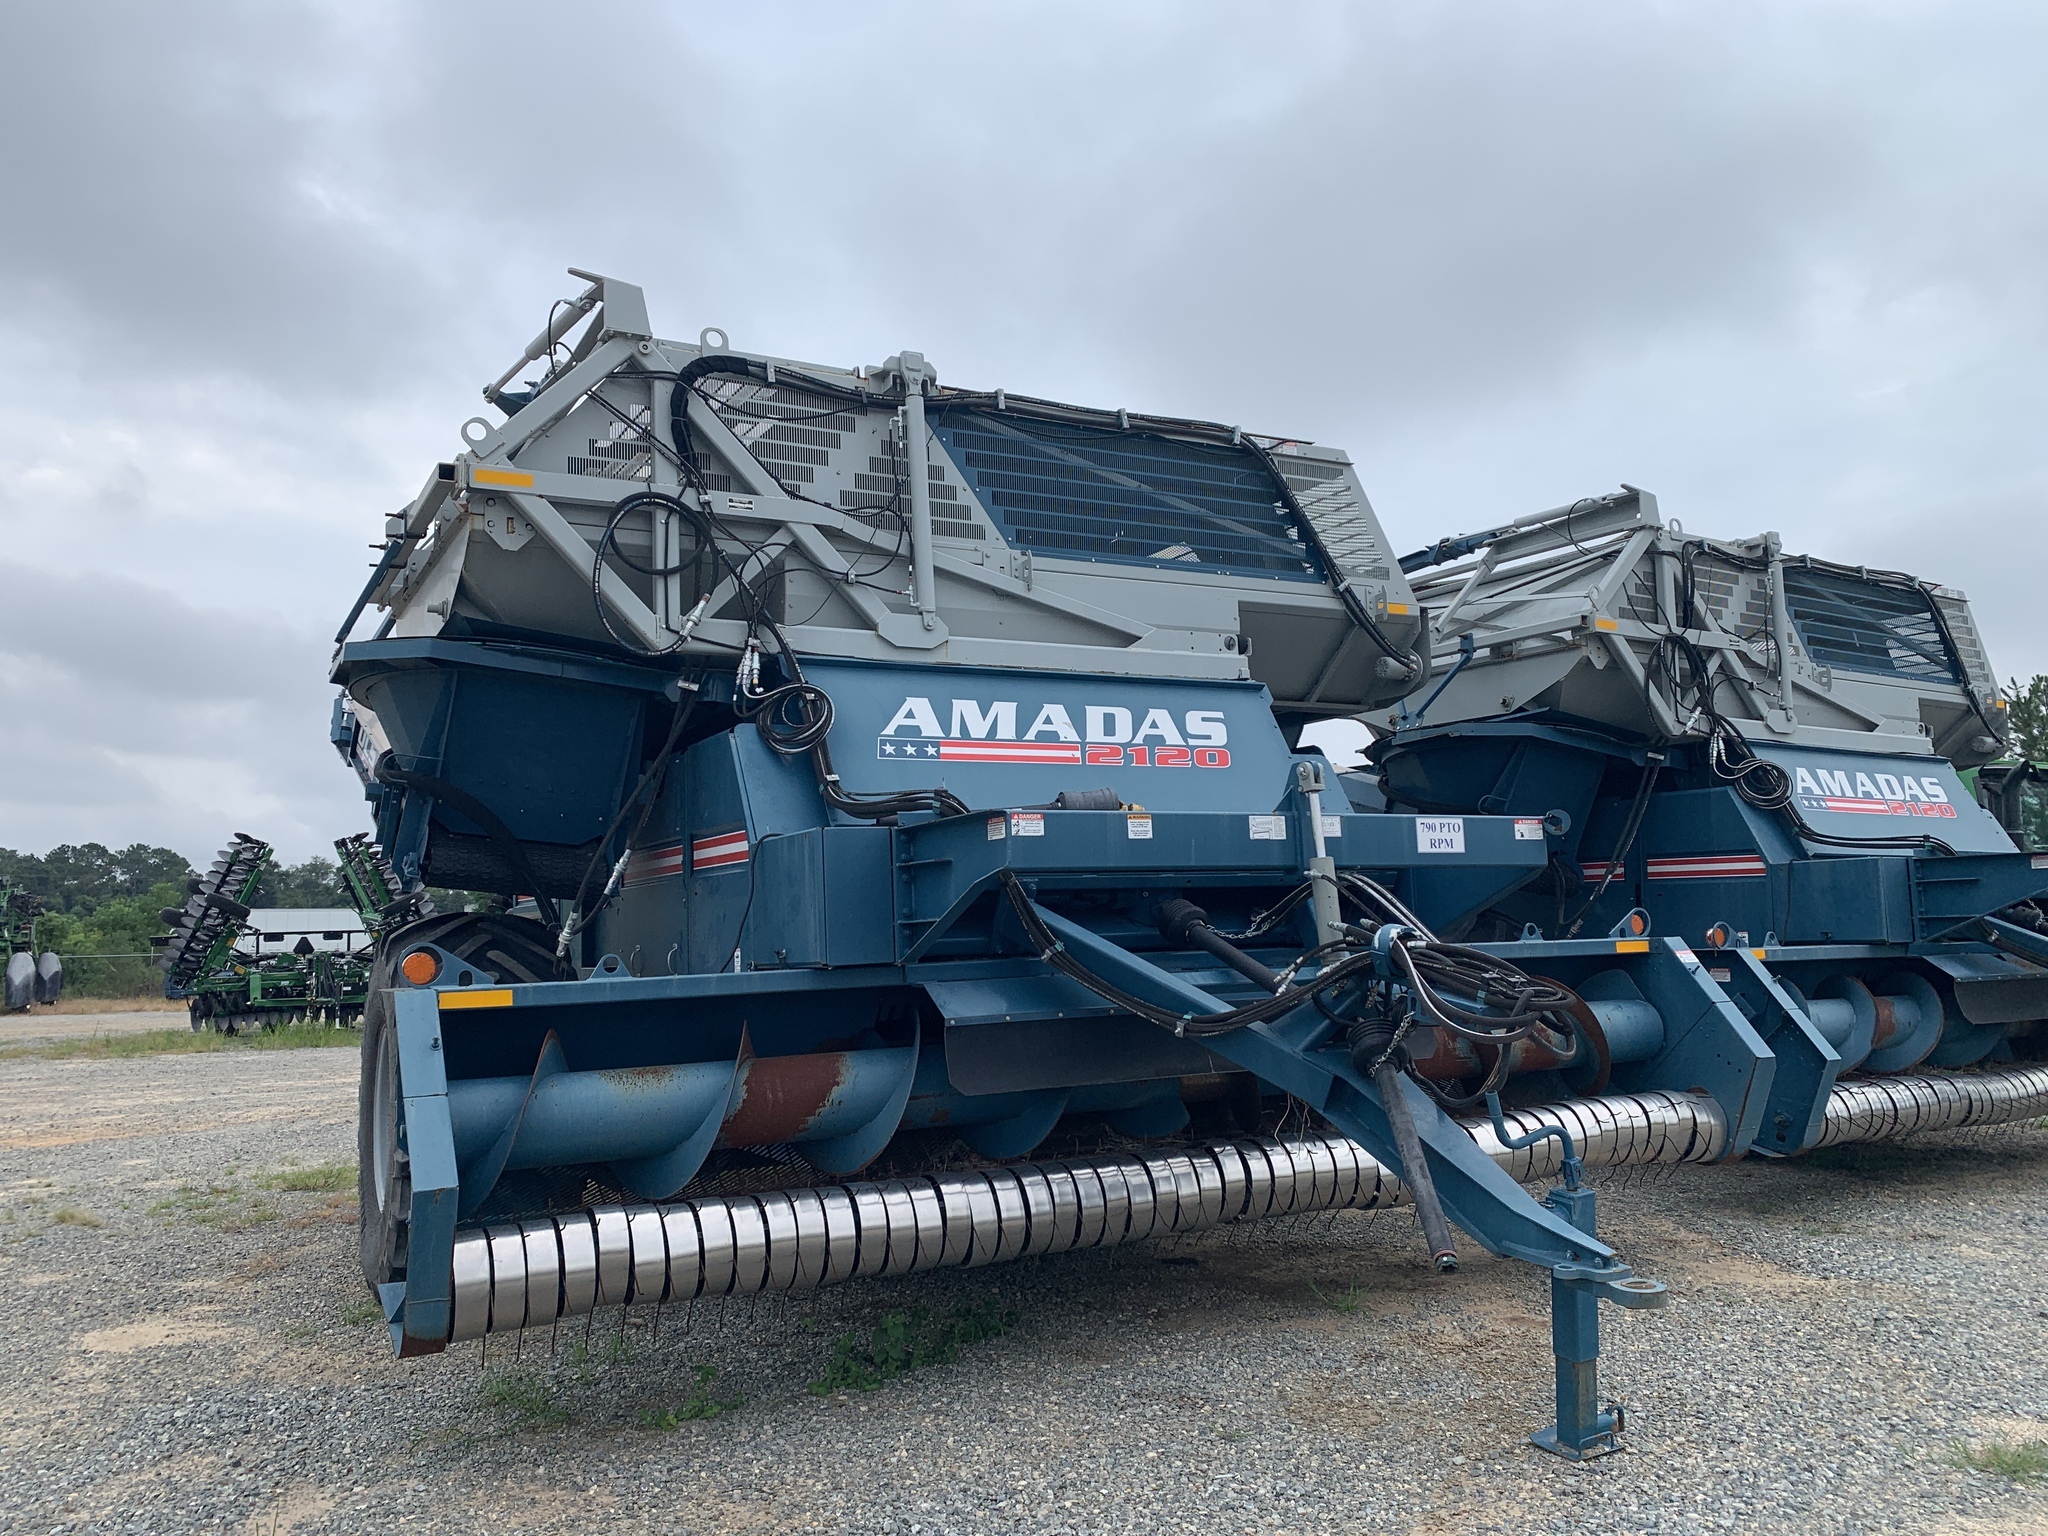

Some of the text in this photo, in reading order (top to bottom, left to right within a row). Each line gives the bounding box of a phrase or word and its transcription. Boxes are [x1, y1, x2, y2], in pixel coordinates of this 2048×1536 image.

[880, 696, 1228, 746] AMADAS
[1085, 744, 1232, 768] 2120
[1796, 767, 1949, 803] AMADAS
[1887, 801, 1957, 819] 2120
[1420, 822, 1461, 833] 790 PTO
[1430, 838, 1454, 849] RPM
